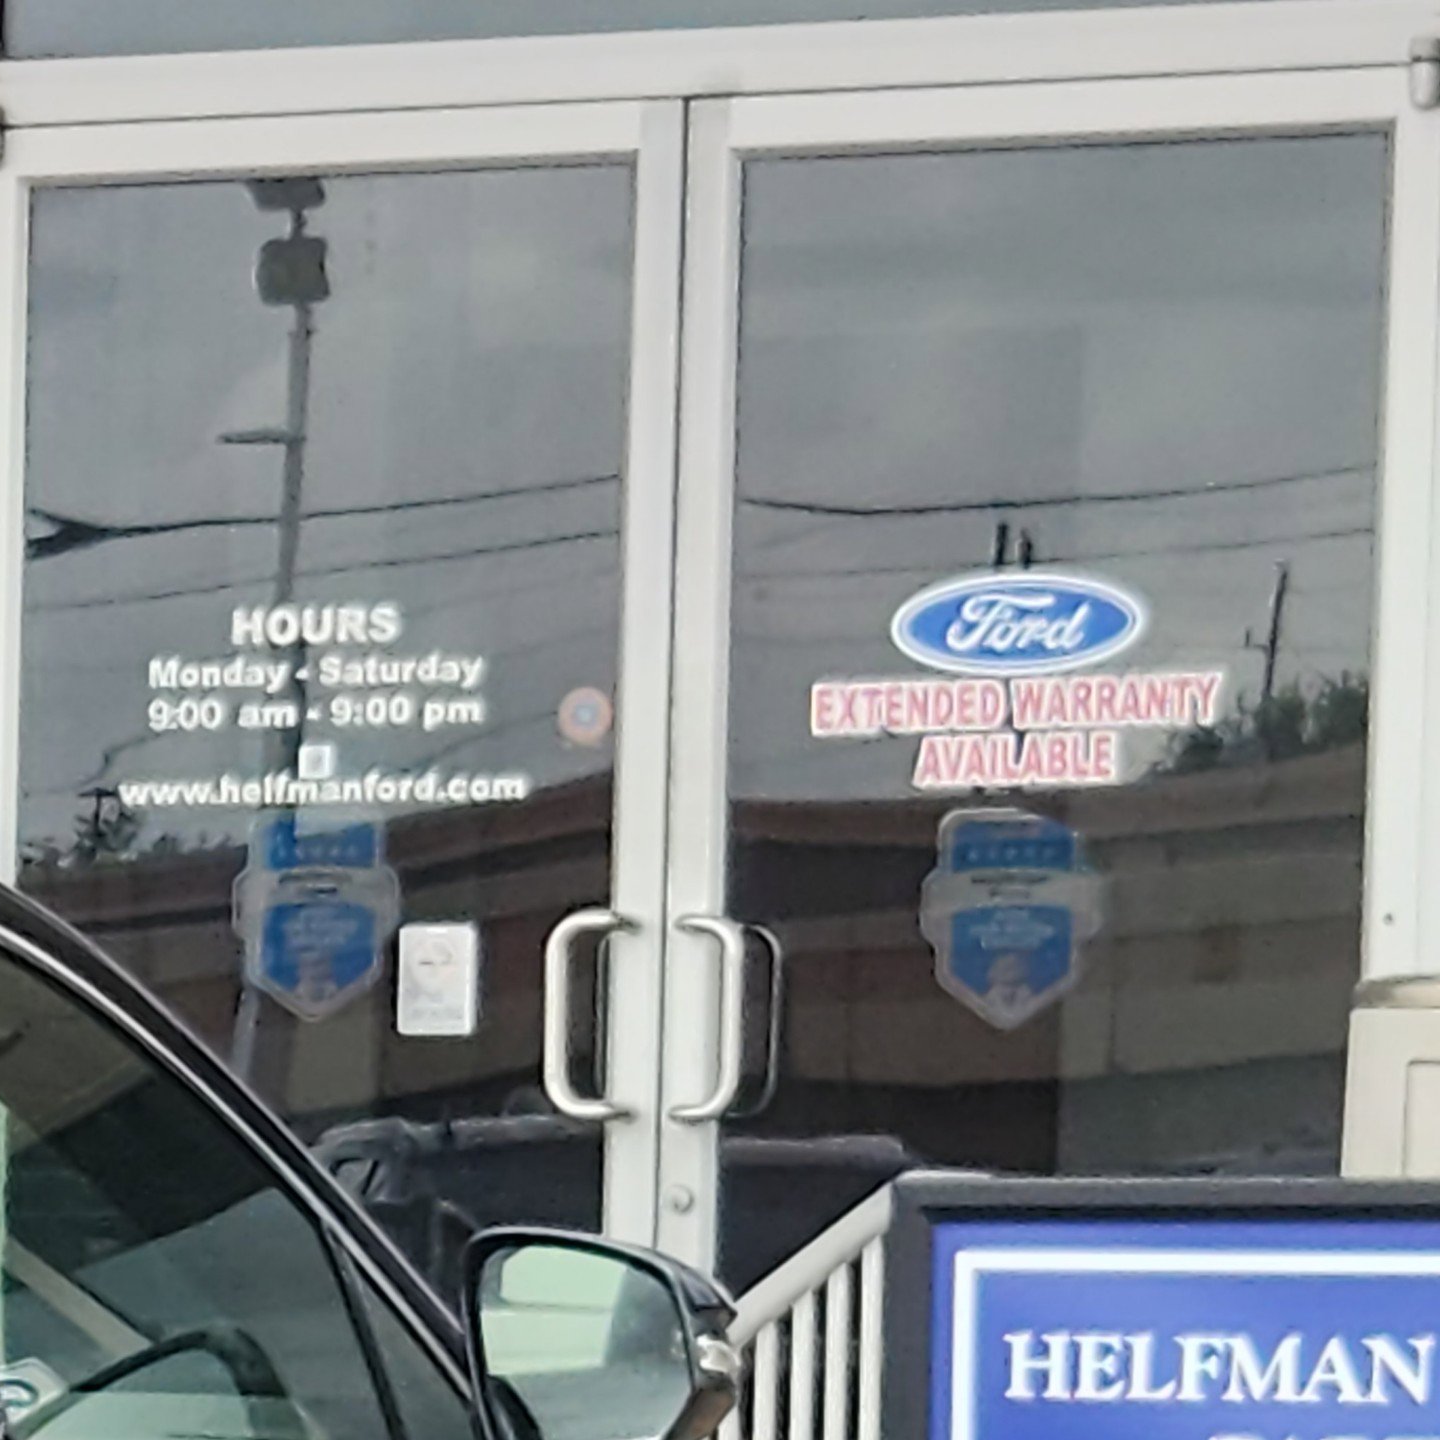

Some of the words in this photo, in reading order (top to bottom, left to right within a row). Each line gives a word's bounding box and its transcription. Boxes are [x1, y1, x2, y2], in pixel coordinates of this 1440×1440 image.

[231, 606, 401, 646] HOURS
[946, 592, 1090, 652] Ford
[148, 658, 287, 692] Monday
[318, 654, 483, 690] Saturday
[148, 700, 223, 731] 9:00
[237, 704, 297, 728] am
[330, 696, 411, 726] 9:00
[423, 698, 483, 731] pm
[812, 681, 1005, 735] EXTENDED
[1011, 673, 1222, 728] WARRANTY
[914, 733, 1118, 788] AVAILABLE
[117, 775, 528, 805] www.helfmanford.com
[1003, 1330, 1436, 1406] HELFMAN
